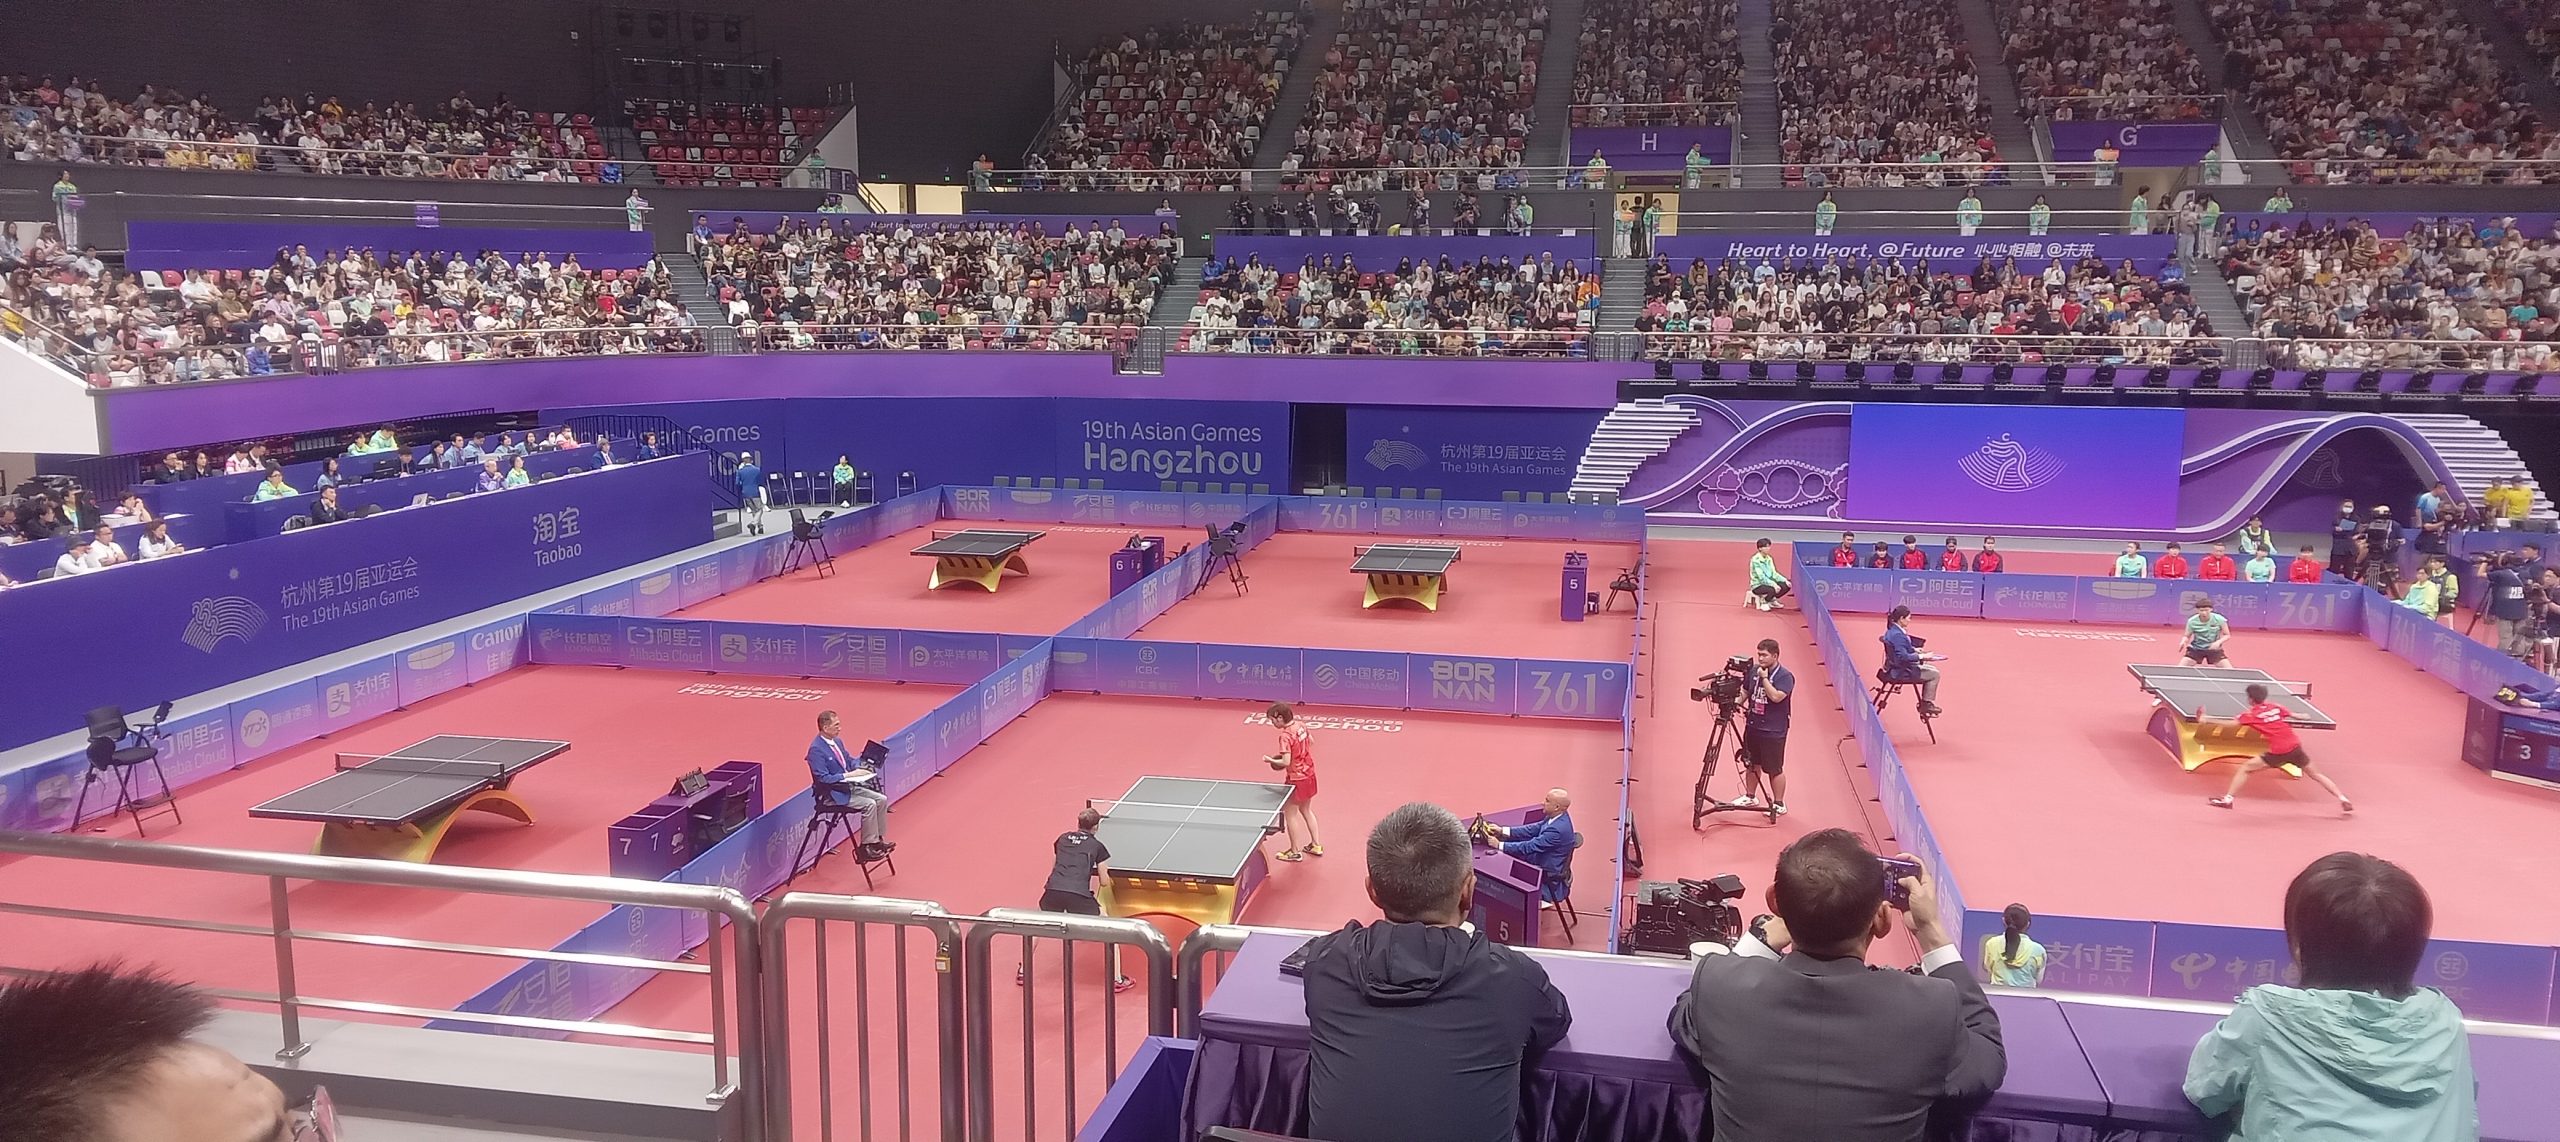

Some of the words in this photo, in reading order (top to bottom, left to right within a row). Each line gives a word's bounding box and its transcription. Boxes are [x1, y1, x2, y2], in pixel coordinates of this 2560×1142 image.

[1641, 133, 1657, 151] H
[2120, 126, 2137, 146] G
[1728, 243, 1782, 257] Heart
[1788, 244, 1808, 258] to
[1812, 242, 1873, 260] Heart,
[1879, 242, 1965, 258] @Future
[688, 424, 760, 445] Games
[1082, 420, 1126, 439] 19th
[1131, 422, 1186, 441] Asian
[1191, 423, 1261, 442] Games
[1084, 441, 1262, 479] Hangzhou
[1440, 444, 1567, 461] 杭州第19届亚运会
[1441, 461, 1461, 473] The
[1465, 462, 1489, 473] 19th
[1492, 463, 1523, 474] Asian
[1526, 464, 1566, 475] Games
[956, 489, 990, 500] BOR
[956, 501, 990, 513] NAN
[532, 506, 581, 545] 淘宝
[534, 543, 582, 567] Taobao
[1116, 560, 1124, 570] 6
[280, 556, 418, 609] 杭州第19届亚运会
[1569, 579, 1578, 589] 5
[1929, 578, 1974, 595] 阿里云
[283, 615, 309, 632] The
[312, 605, 340, 625] 19th
[343, 594, 377, 617] Asian
[379, 585, 420, 606] Games
[1899, 595, 1939, 608] Alibaba
[1942, 598, 1973, 610] Cloud
[2213, 595, 2258, 610] 支付宝
[2279, 589, 2352, 627] 361°
[471, 623, 523, 651] Canon
[657, 628, 702, 647] 阿里云
[752, 637, 797, 654] 支付宝
[629, 647, 669, 662] Alibaba
[672, 648, 703, 663] Cloud
[1135, 665, 1160, 675] ICBC
[1344, 666, 1399, 682] 中国移动
[1433, 661, 1495, 682] BOR
[353, 672, 391, 699] 支付宝
[678, 685, 823, 702] Hangzhou
[1433, 681, 1496, 703] NAN
[1530, 668, 1616, 714] 361°
[177, 718, 225, 752] 阿里云
[195, 745, 227, 769] Cloud
[2520, 745, 2532, 760] 3
[619, 838, 632, 855] 7
[651, 832, 659, 851] 7
[1499, 920, 1510, 941] 5
[2046, 941, 2134, 973] 支付宝
[2047, 971, 2130, 988] ALIPAY
